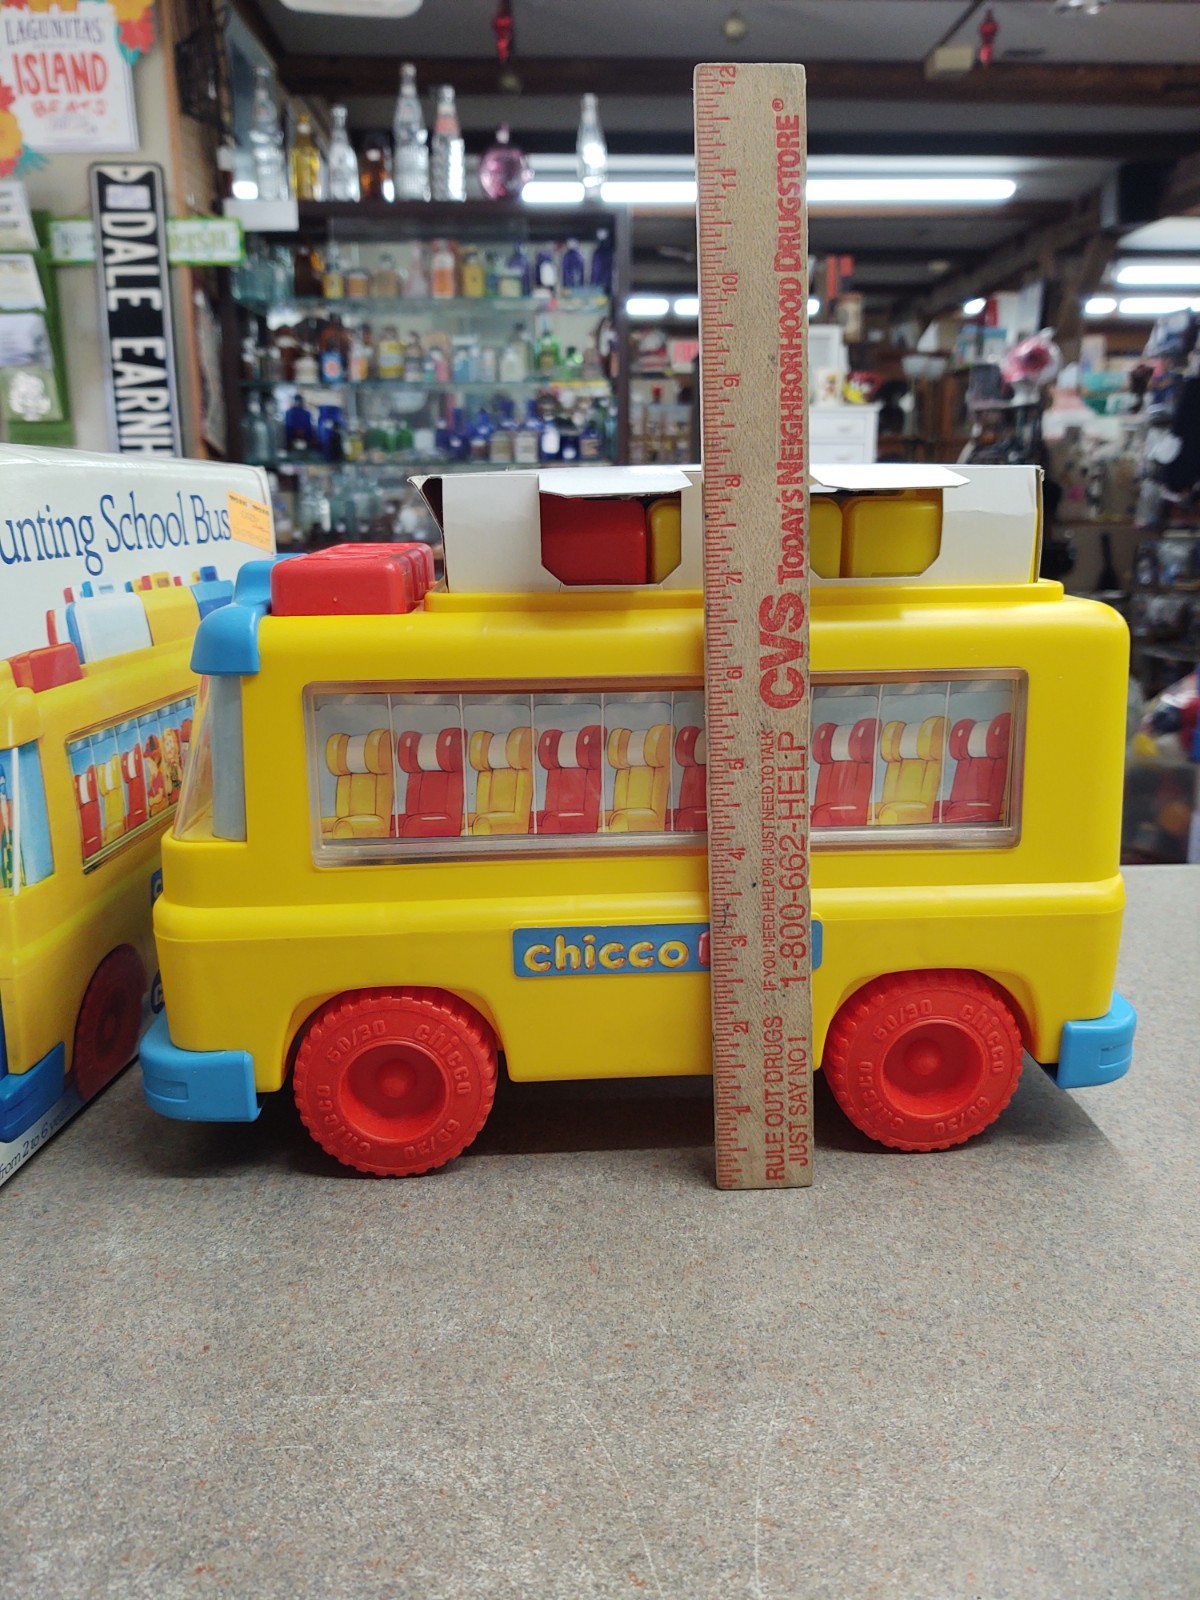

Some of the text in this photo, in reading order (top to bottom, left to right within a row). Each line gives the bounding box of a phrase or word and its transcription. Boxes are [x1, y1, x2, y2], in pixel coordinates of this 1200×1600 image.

[11, 51, 109, 95] ISLAND
[719, 65, 736, 87] 12
[721, 170, 737, 190] 11
[102, 212, 163, 312] DALE
[721, 275, 738, 294] 10
[723, 377, 740, 388] 9
[776, 277, 804, 486] NEIGHBORHOOD
[724, 477, 741, 488] 8
[99, 490, 190, 553] School
[190, 494, 232, 545] Bus
[725, 575, 742, 585] 7
[758, 592, 805, 710] CVS
[726, 670, 743, 681] 6
[728, 759, 744, 771] 5
[729, 849, 746, 861] 4
[760, 729, 776, 991] IF YOU NEED HELP OR JUST NEED TO TALK
[777, 731, 807, 988] 1-800-662-HELP
[523, 933, 690, 972] chicco
[731, 936, 747, 947] 3
[733, 1022, 749, 1034] 2
[735, 1106, 751, 1116] 1
[763, 1016, 785, 1181] RULE OUT DRUGS
[788, 1084, 808, 1116] SAY
[22, 1140, 30, 1158] 2
[41, 1122, 48, 1139] 6
[788, 1122, 808, 1167] JUST
